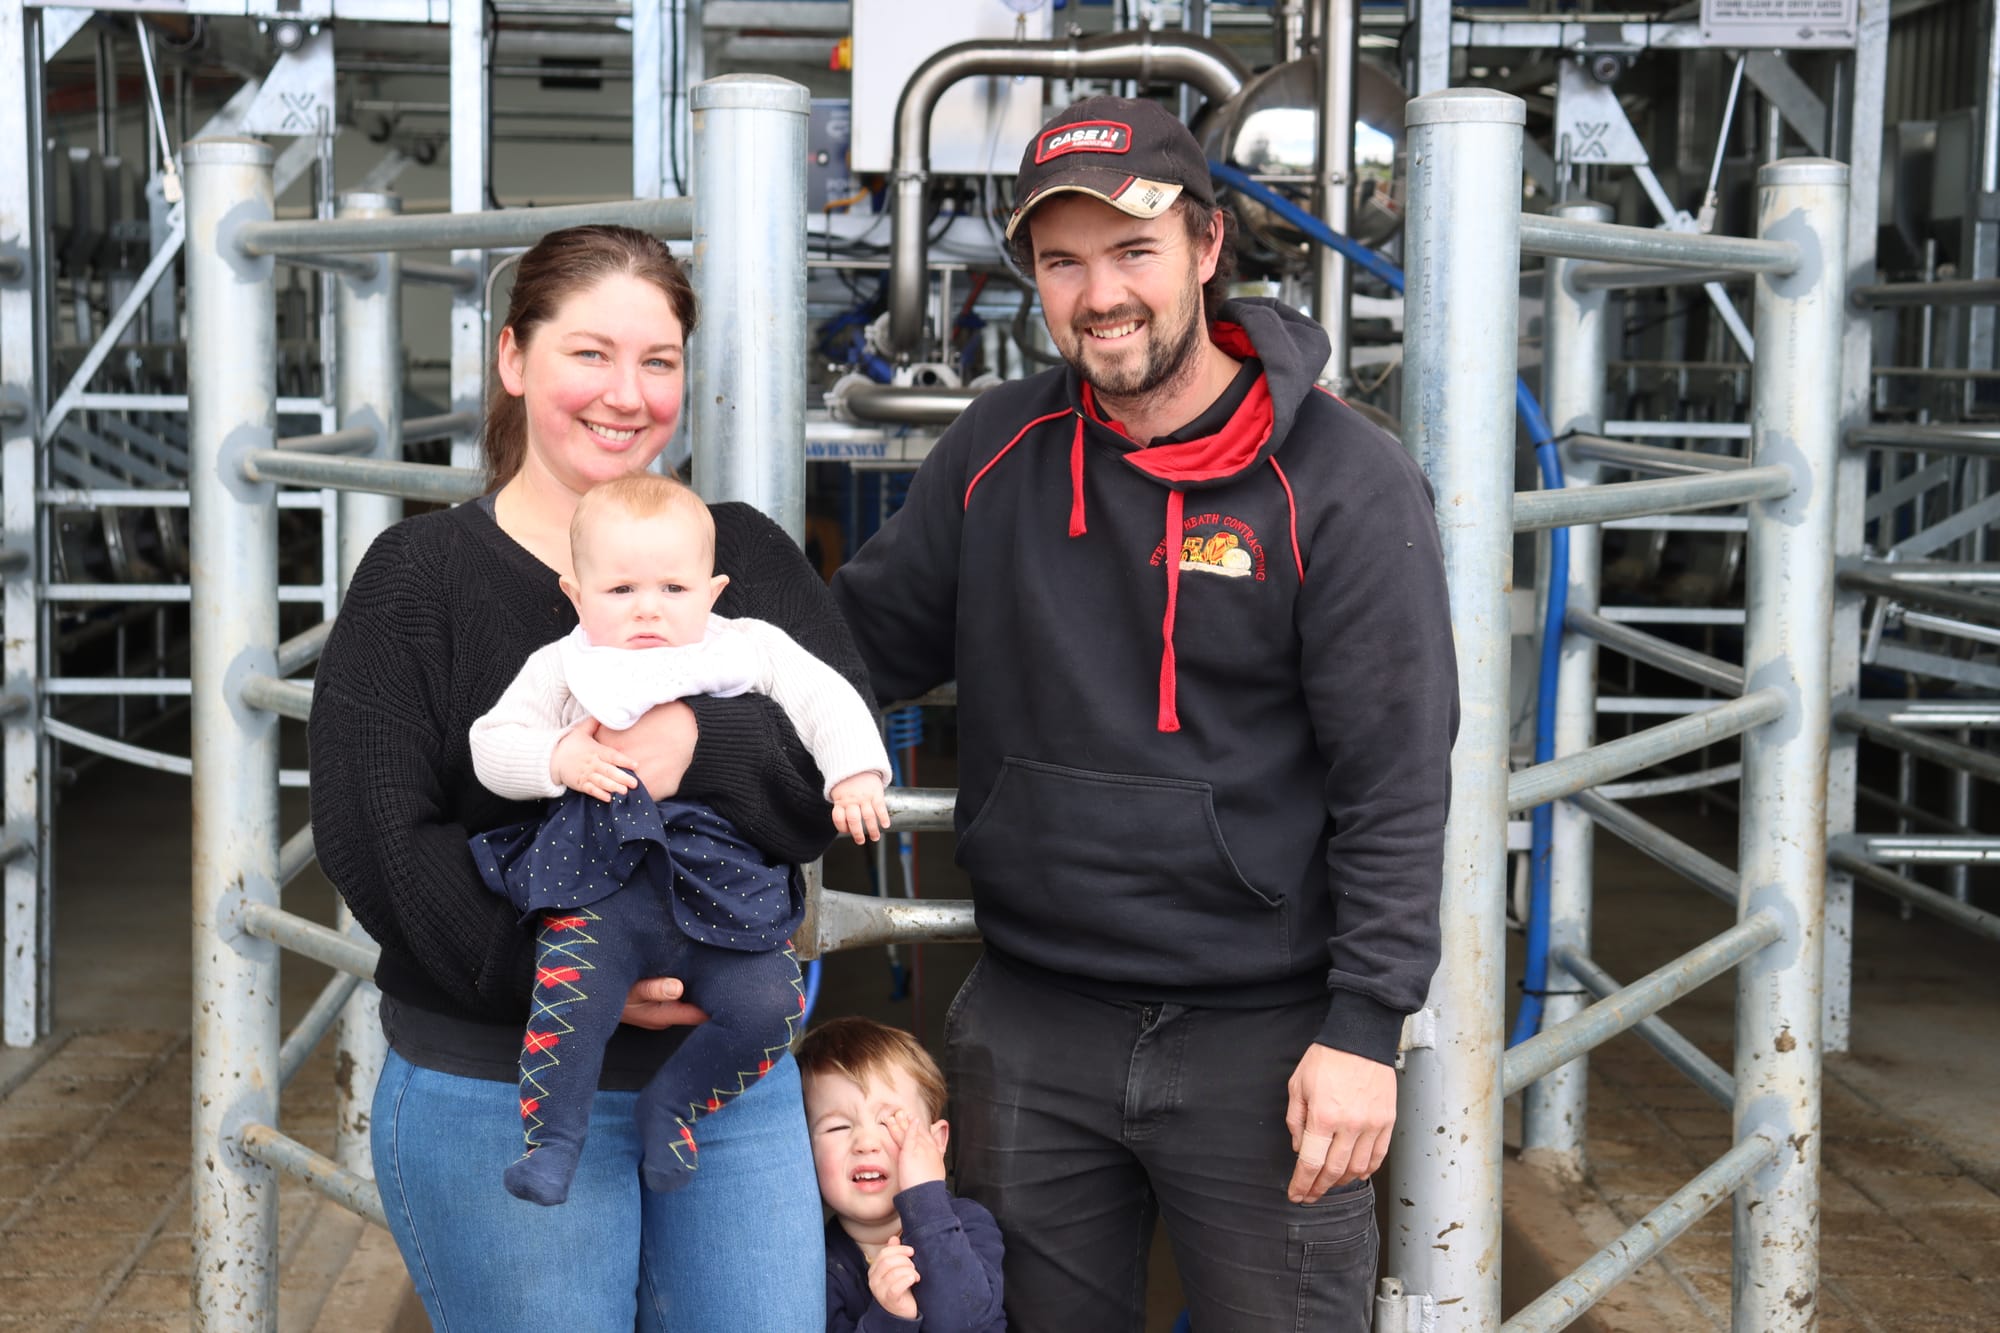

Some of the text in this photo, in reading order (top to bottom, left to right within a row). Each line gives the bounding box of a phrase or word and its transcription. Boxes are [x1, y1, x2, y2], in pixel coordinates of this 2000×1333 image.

[1049, 130, 1099, 150] CASE
[1183, 513, 1220, 531] HEATH
[1223, 516, 1266, 581] CONTRACTING
